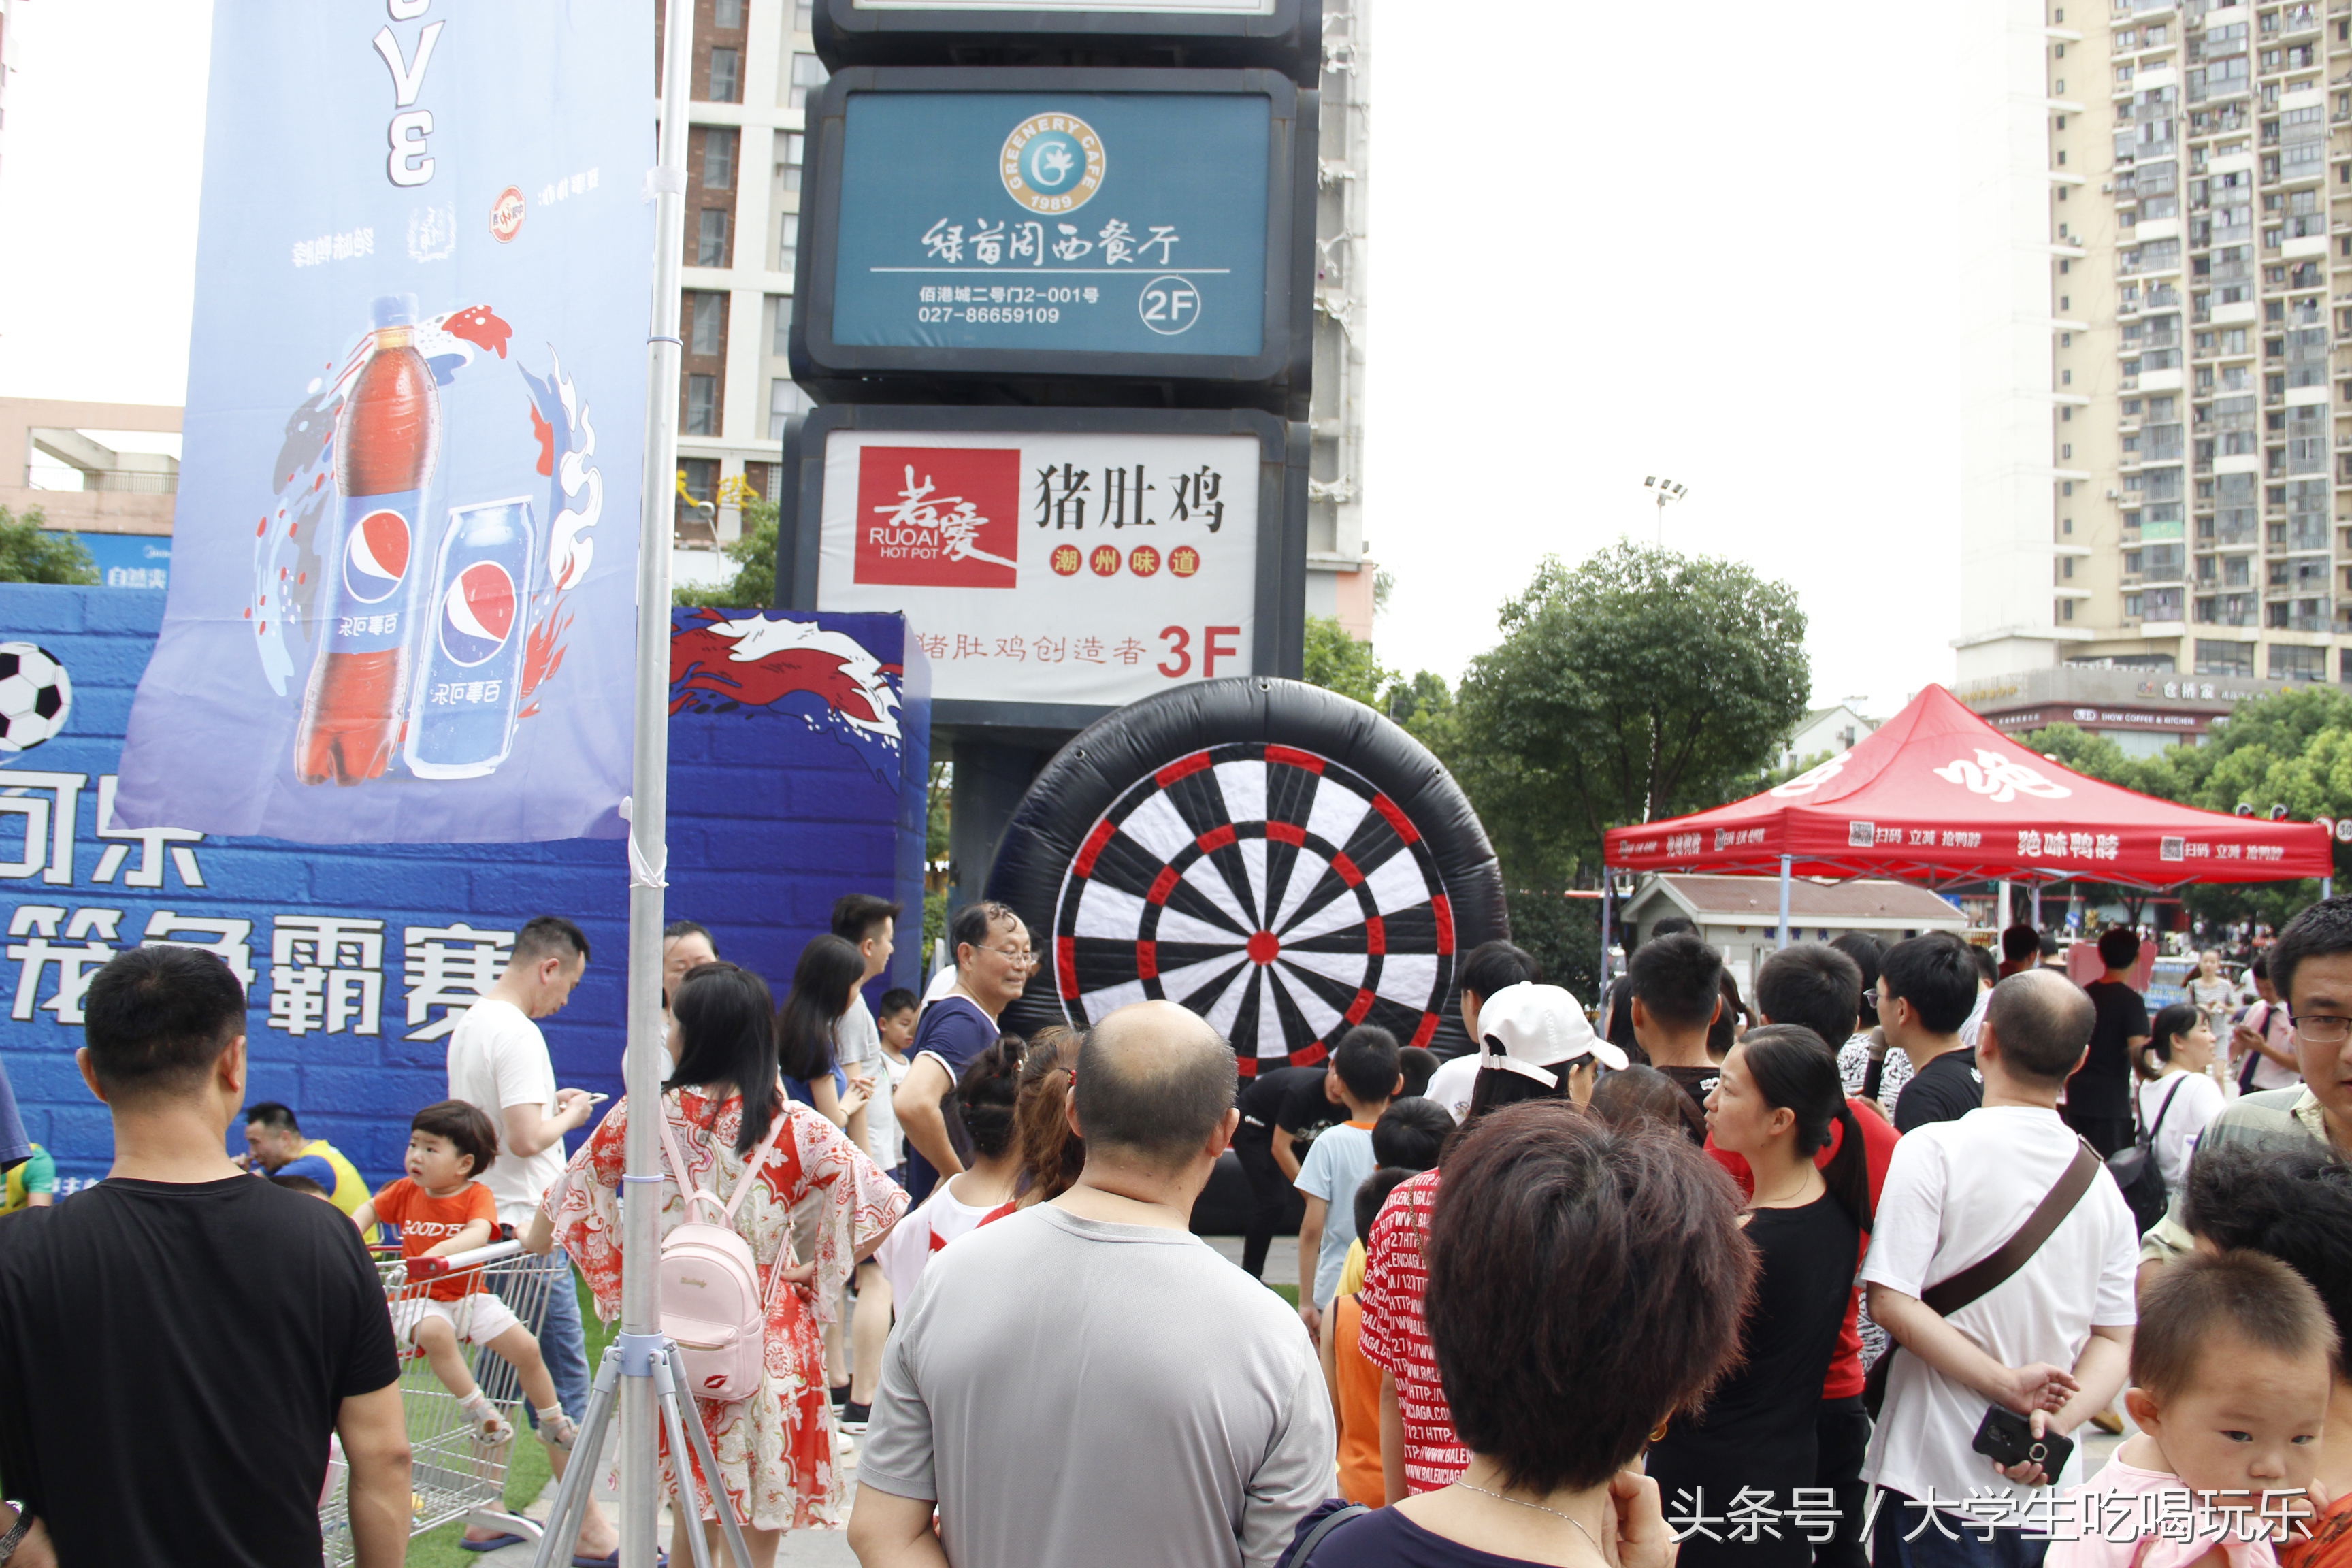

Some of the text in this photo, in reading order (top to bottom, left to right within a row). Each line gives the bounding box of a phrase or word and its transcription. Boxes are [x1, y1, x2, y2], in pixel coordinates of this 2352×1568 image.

[1005, 117, 1101, 190] GREENERY CAFE
[1031, 195, 1073, 210] 1989
[919, 286, 1100, 304] 佰港城二号门2-001号
[1145, 290, 1195, 321] 2F
[918, 307, 1060, 323] 027-86659109
[1034, 462, 1224, 534] 猪肚鸡
[869, 527, 939, 547] RUOAI
[880, 546, 939, 559] HOT POT
[1054, 547, 1198, 574] 潮州味道
[915, 632, 1147, 665] 猪肚鸡创造者
[1157, 625, 1241, 679] 3F
[2016, 829, 2119, 860] 绝味鸭脖
